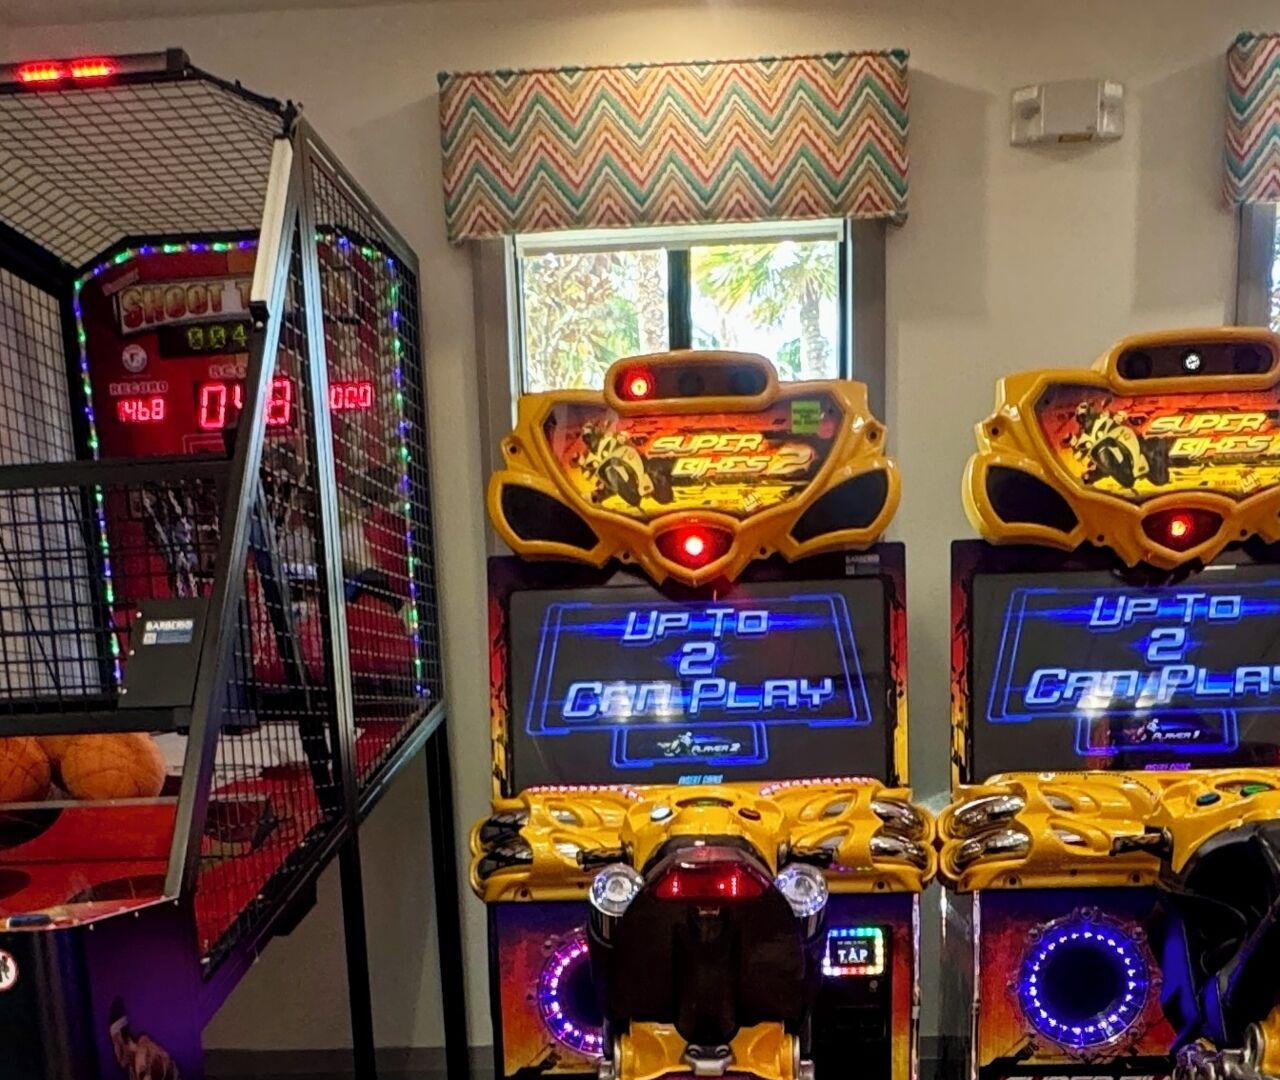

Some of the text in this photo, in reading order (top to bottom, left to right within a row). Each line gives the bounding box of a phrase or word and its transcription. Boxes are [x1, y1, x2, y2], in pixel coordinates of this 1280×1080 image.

[122, 283, 225, 329] SHOOT
[1148, 413, 1267, 434] SUPER
[650, 433, 764, 454] SUPER
[1169, 435, 1272, 458] BIKES
[671, 443, 815, 477] BIKES 2
[678, 641, 716, 675] 2
[1147, 628, 1186, 662] 2
[837, 947, 869, 964] TAP
